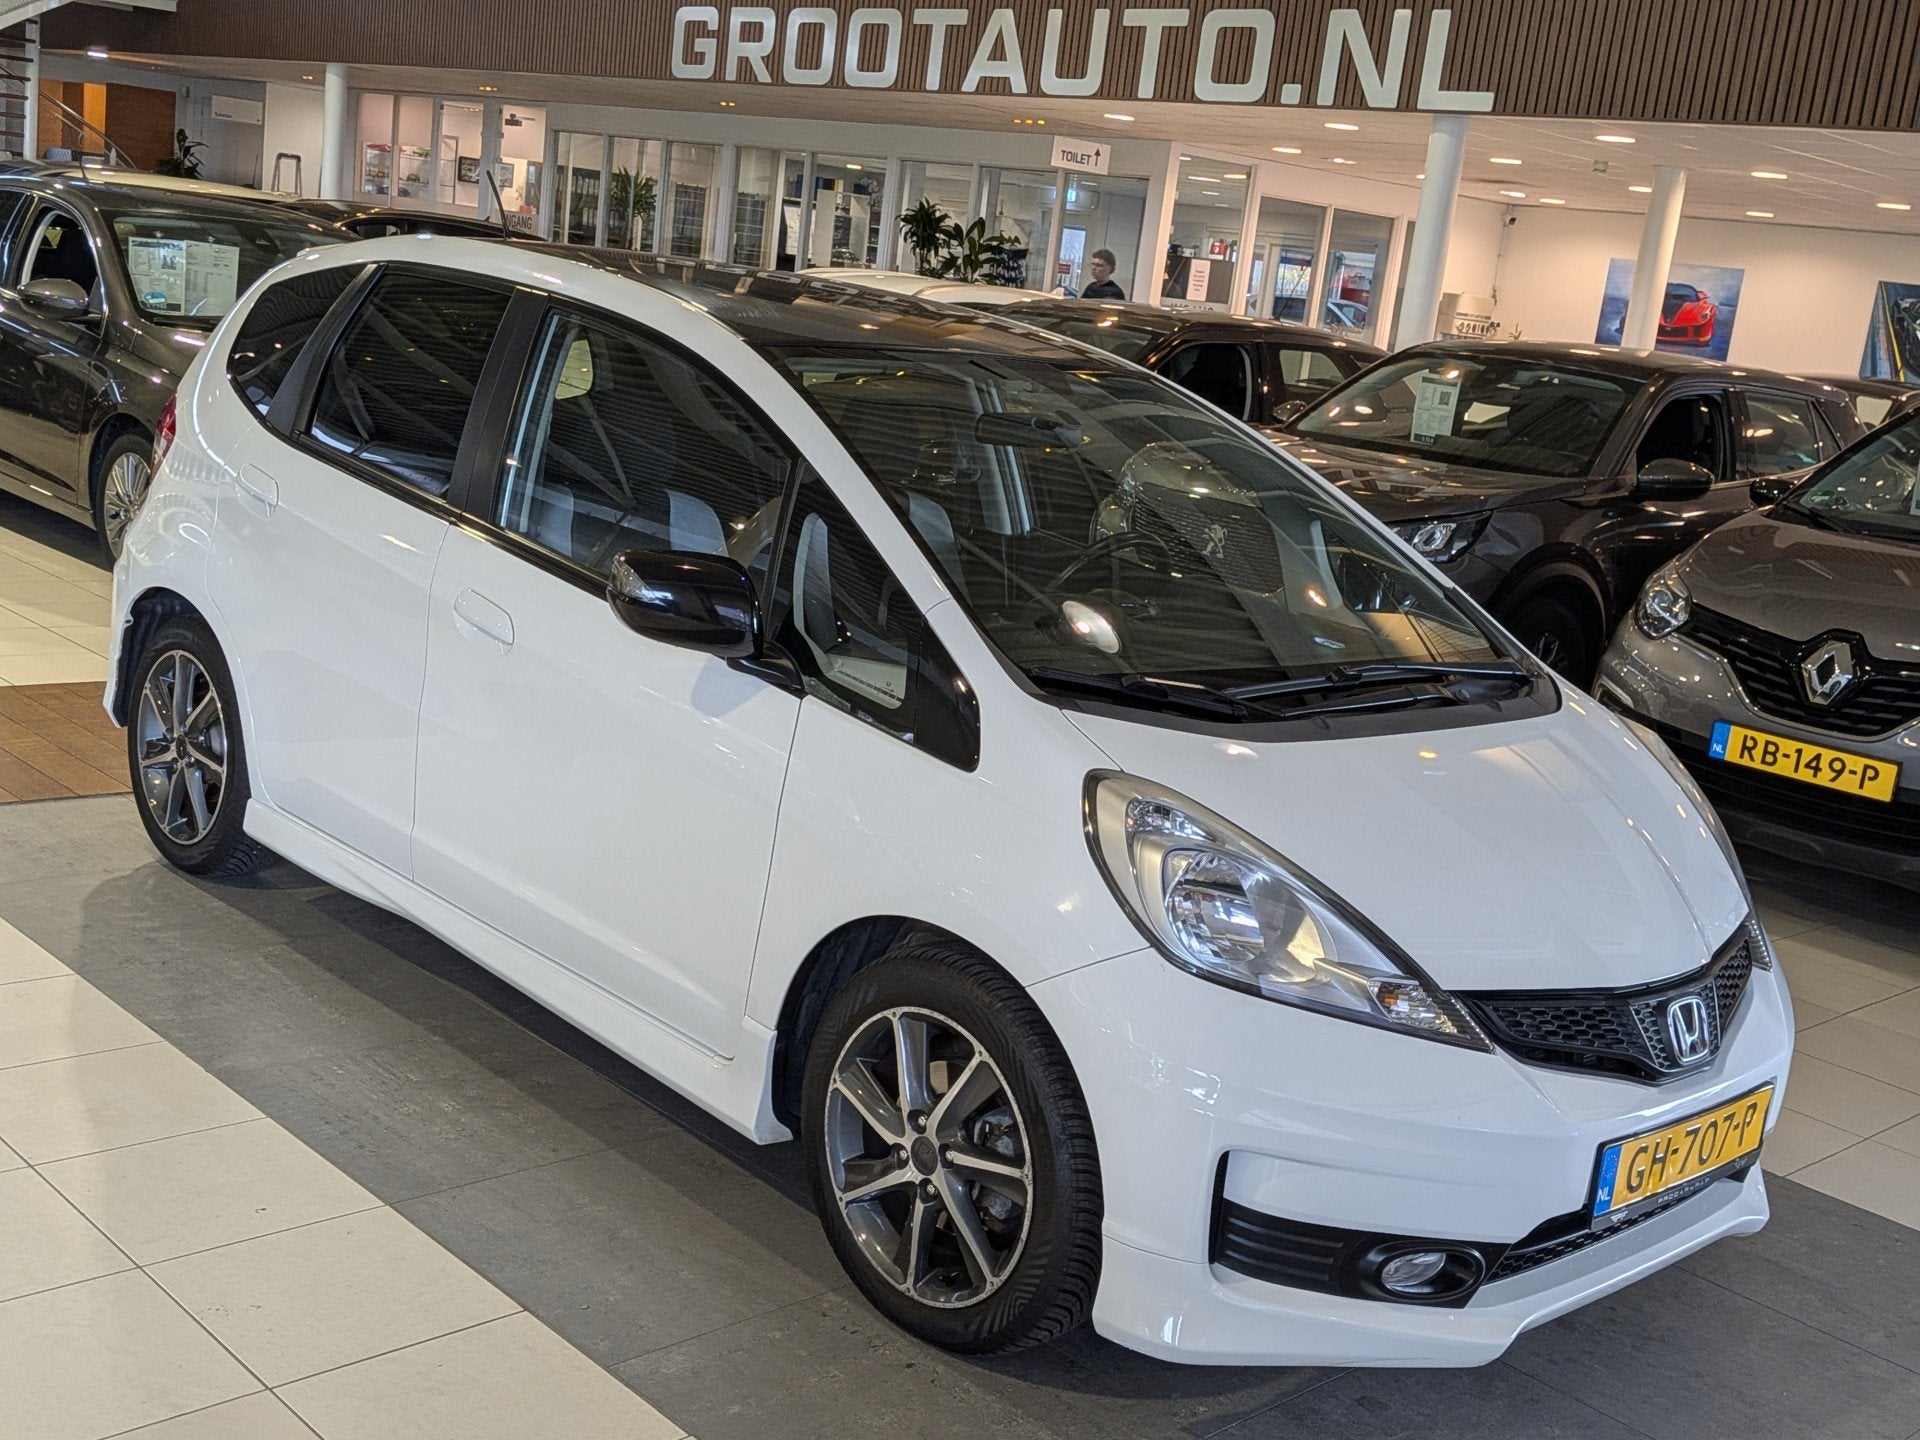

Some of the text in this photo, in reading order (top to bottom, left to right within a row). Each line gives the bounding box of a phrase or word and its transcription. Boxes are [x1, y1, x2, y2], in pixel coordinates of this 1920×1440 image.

[671, 6, 1495, 112] GROOTAUTO.NL
[1061, 150, 1092, 166] TOILET
[1712, 743, 1725, 755] NL
[1739, 734, 1880, 790] RB-149-P
[1626, 1101, 1758, 1194] GH-707-P
[1597, 1186, 1611, 1203] NL
